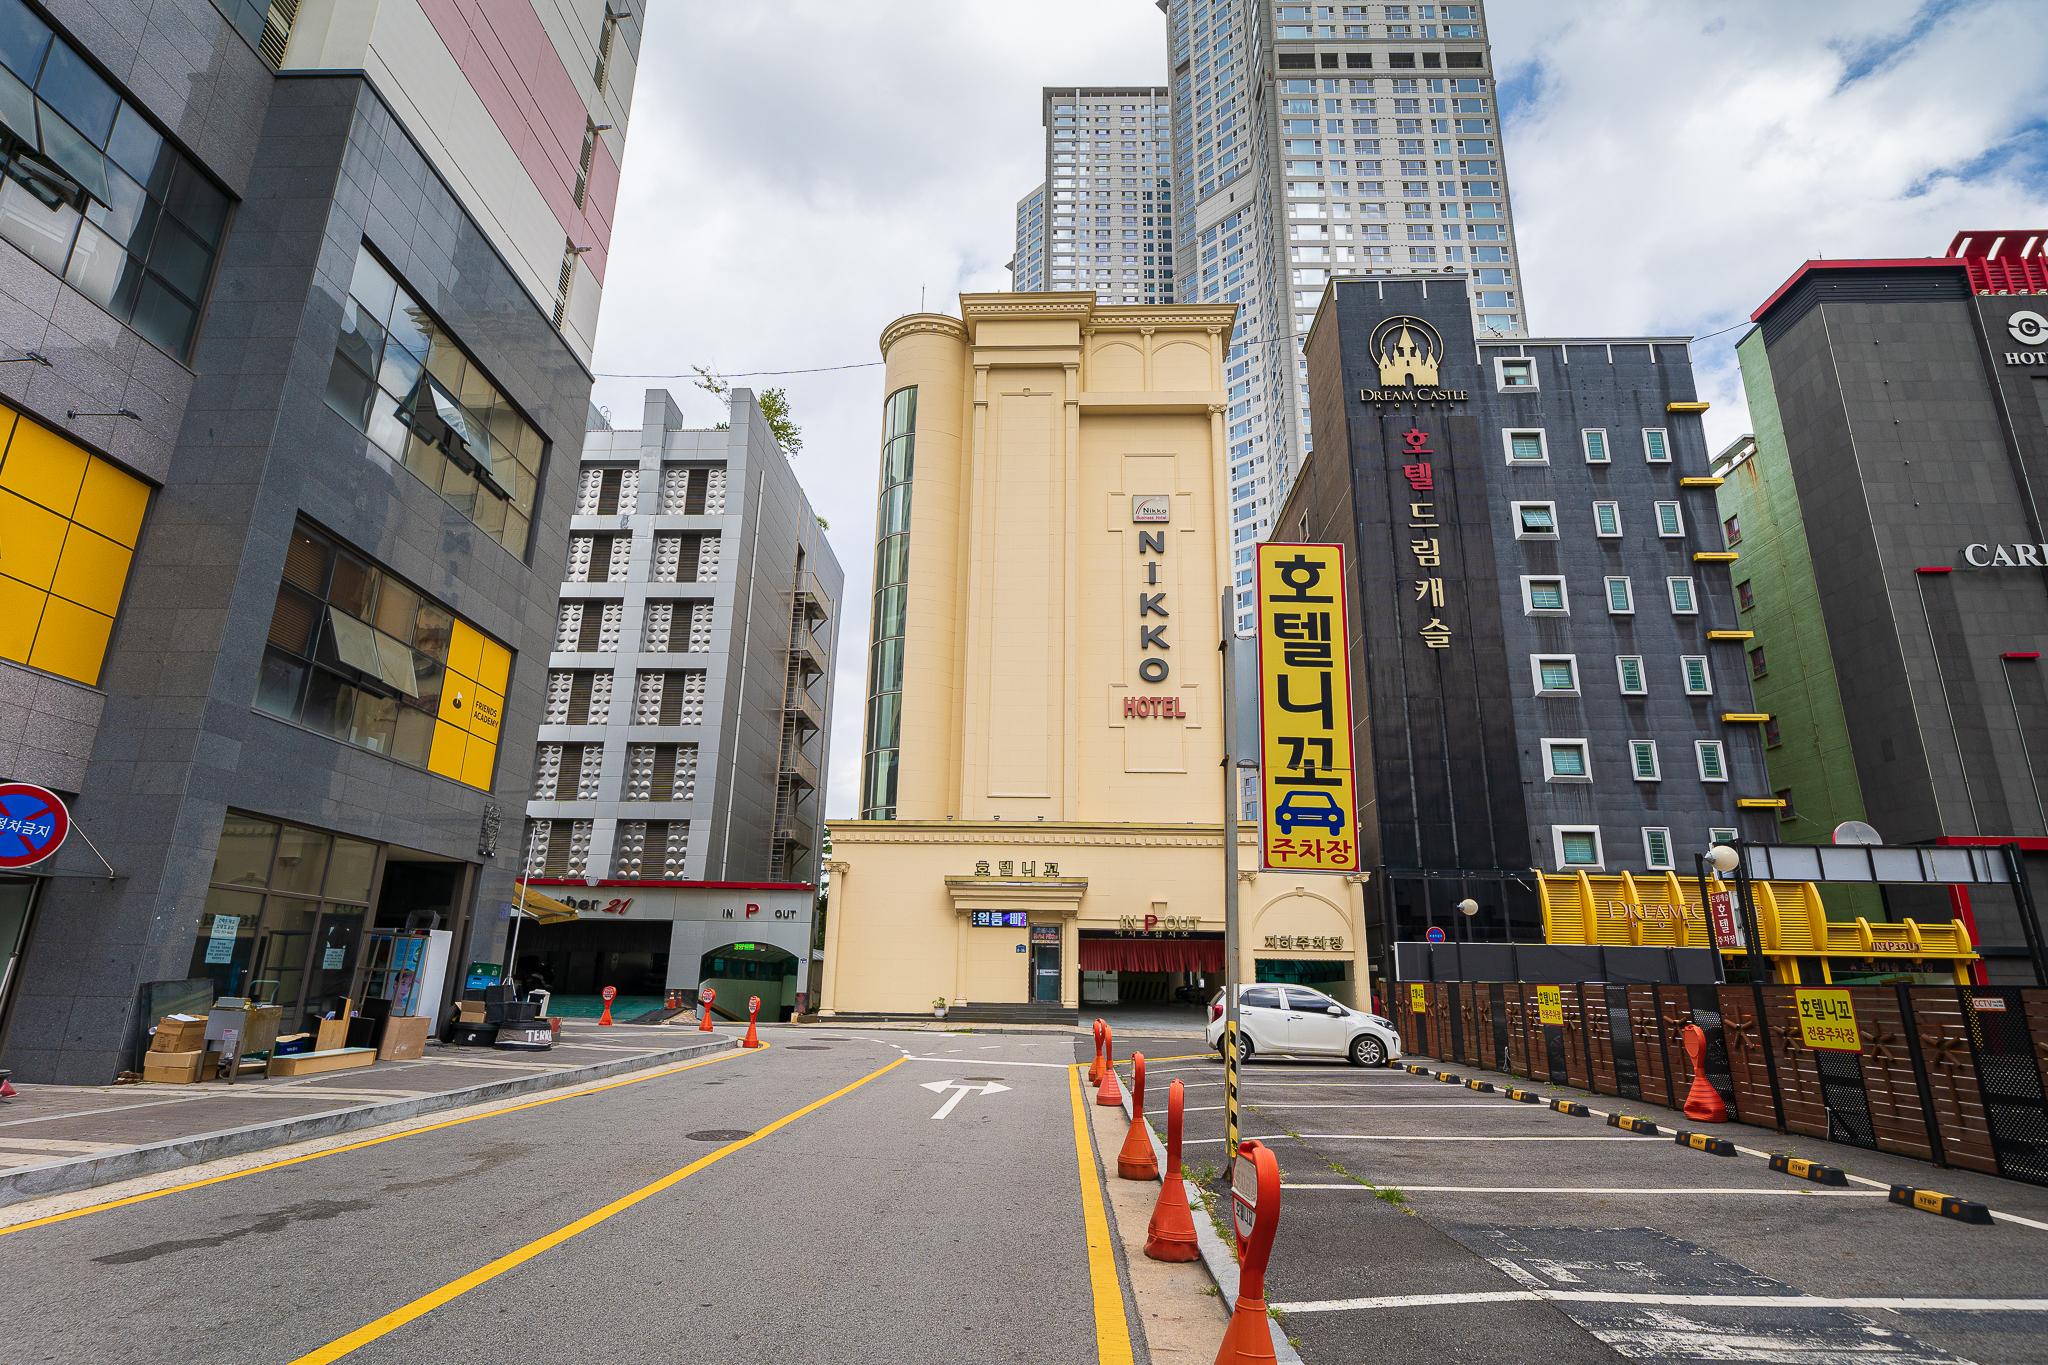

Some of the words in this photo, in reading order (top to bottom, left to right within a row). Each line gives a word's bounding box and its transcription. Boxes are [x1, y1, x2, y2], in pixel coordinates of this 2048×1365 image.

[2004, 351, 2048, 365] HOT
[1360, 388, 1414, 401] DREAM
[1417, 388, 1469, 401] CASTLE
[1402, 428, 1434, 491] 호텔
[1409, 503, 1452, 649] 드림캐슬
[1139, 530, 1170, 683] NIKKO
[1269, 554, 1342, 787] 호텔니꼬
[475, 700, 498, 718] FRIENDS
[1123, 696, 1186, 718] HOTEL
[473, 710, 499, 729] ACADEMY
[1270, 838, 1352, 864] 주차장
[975, 860, 1059, 877] 호텔니꼬
[602, 897, 633, 916] 21
[722, 909, 734, 919] IN
[745, 903, 760, 919] P
[775, 909, 797, 919] OUT
[1607, 900, 1689, 921] DREAM
[1119, 915, 1136, 930] IN
[1144, 914, 1158, 932] P
[1164, 915, 1201, 931] OUT
[1715, 903, 1730, 934] 호텔
[1264, 935, 1344, 950] 지하주차장
[1717, 934, 1737, 945] 주차장
[1800, 998, 1852, 1021] 호텔니꼬
[1807, 1025, 1855, 1043] 전용주차장
[1791, 1163, 1806, 1173] STOP
[1919, 1196, 1937, 1207] STOP
